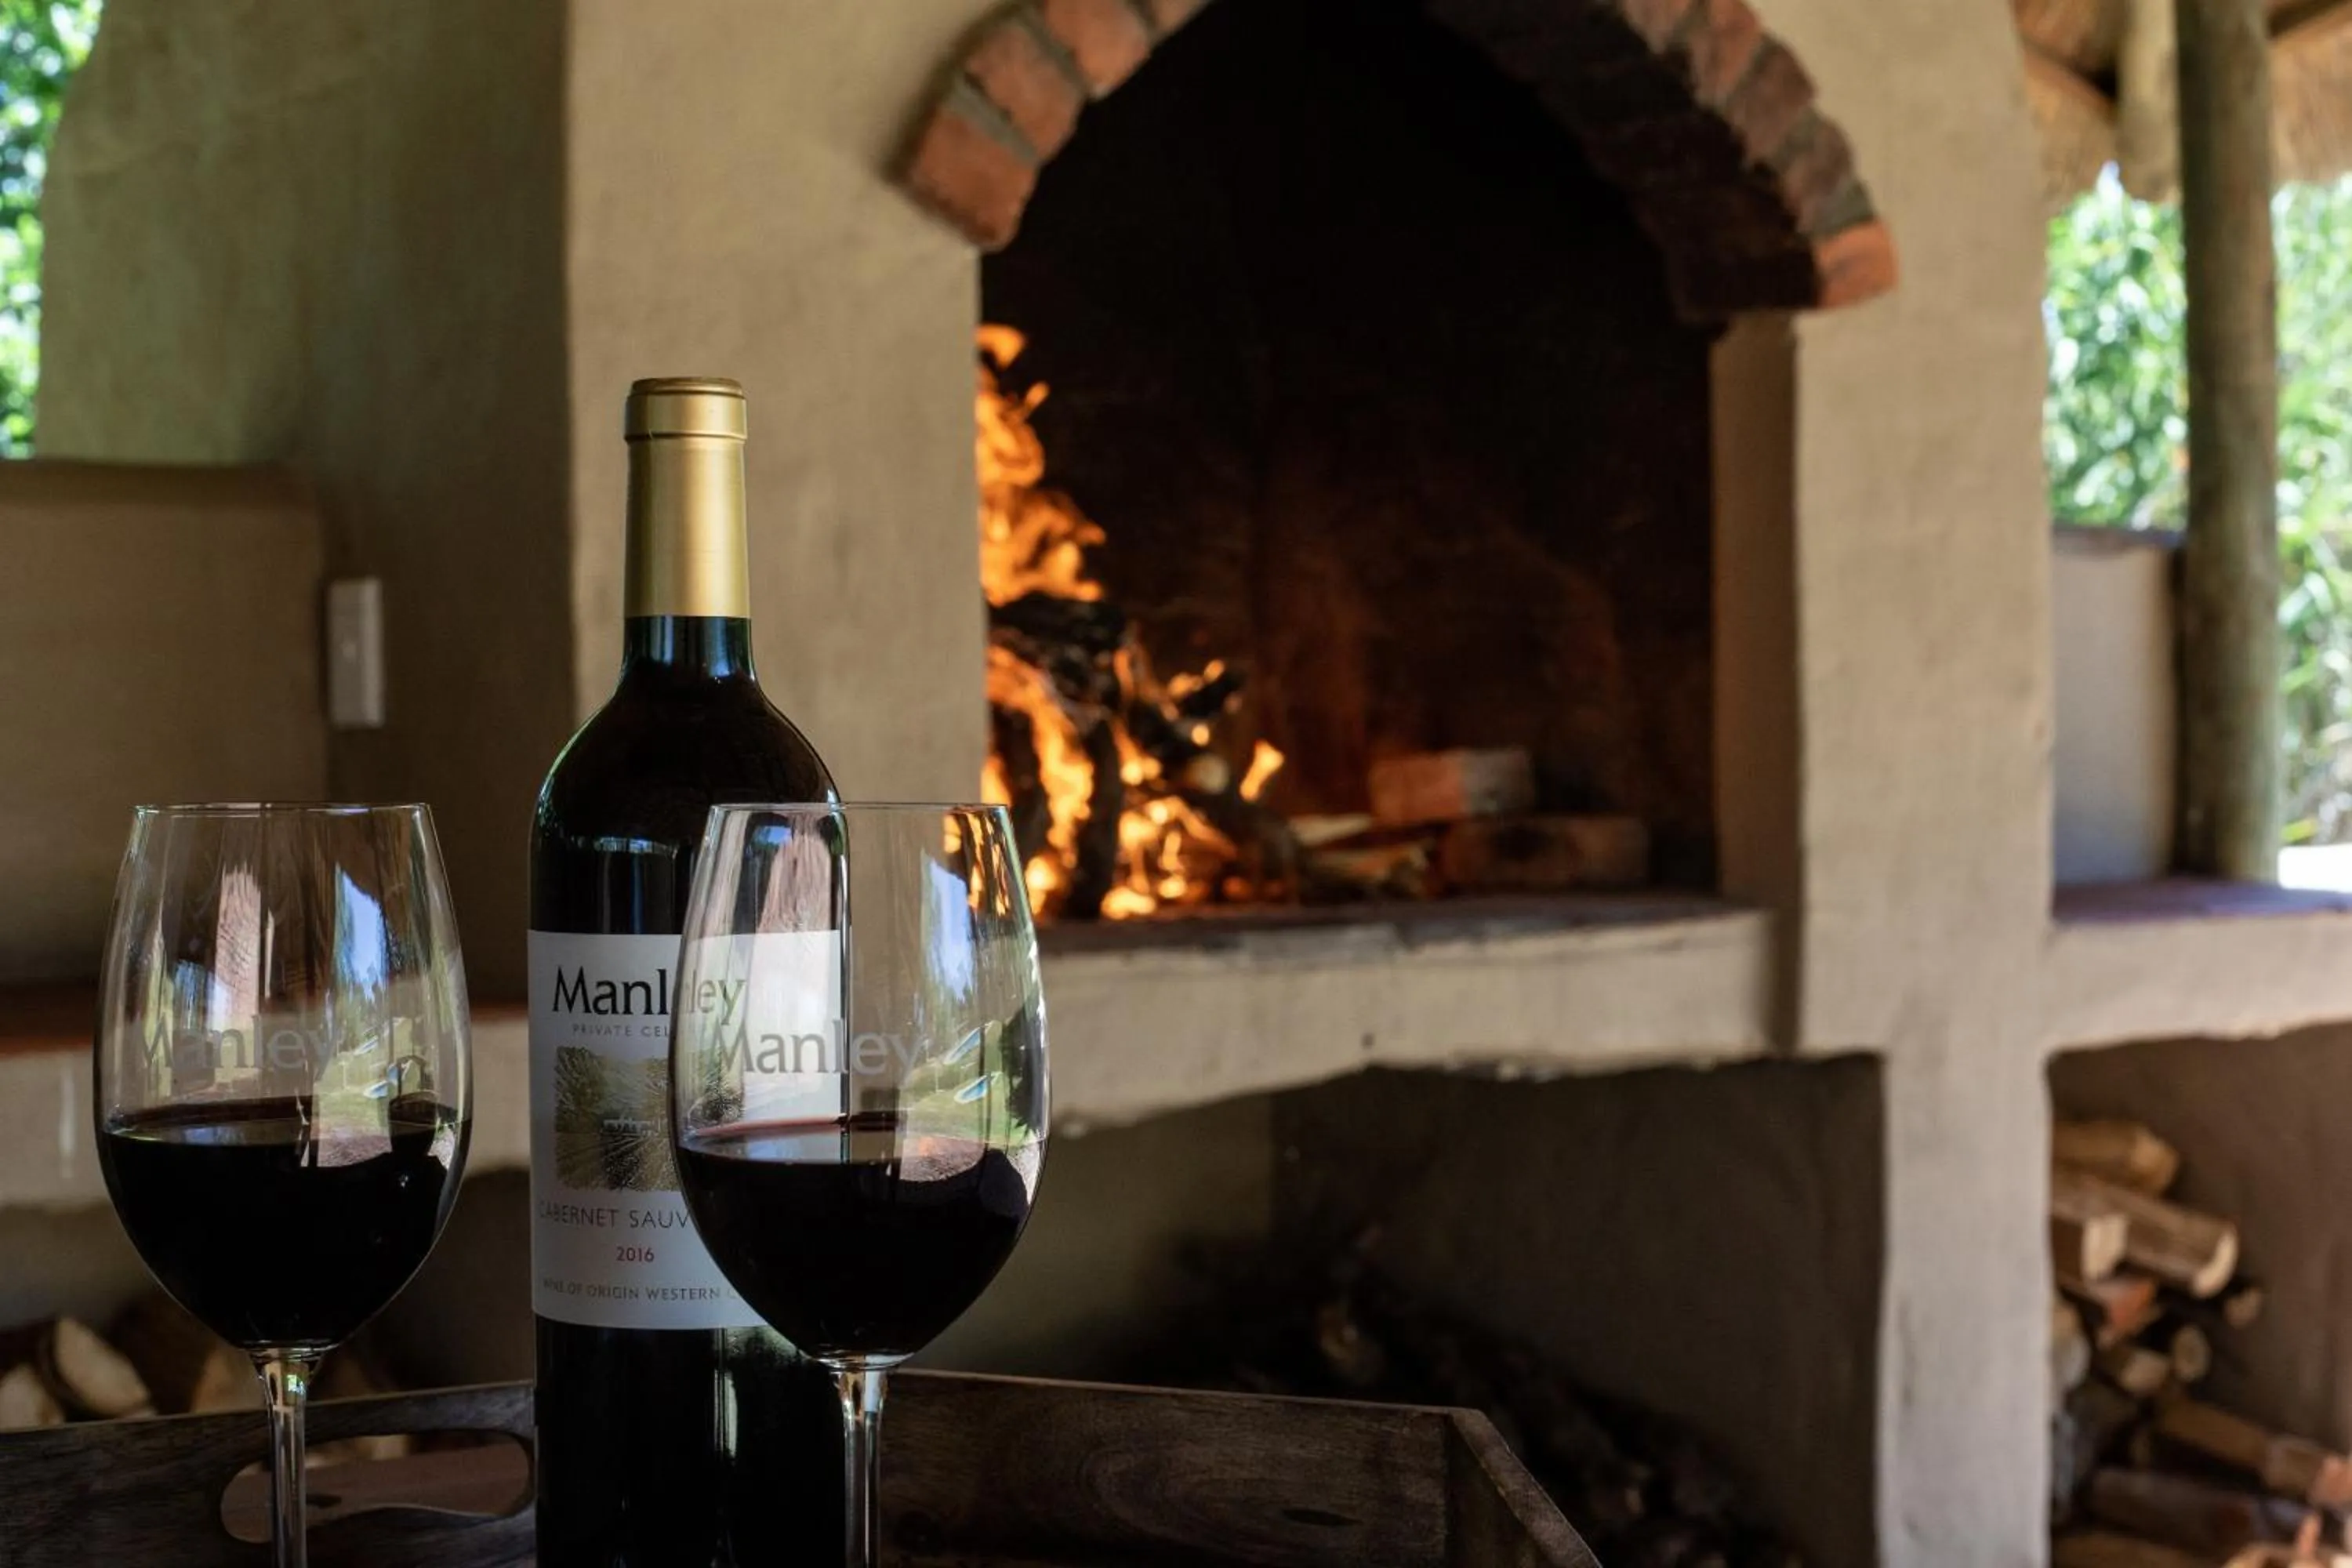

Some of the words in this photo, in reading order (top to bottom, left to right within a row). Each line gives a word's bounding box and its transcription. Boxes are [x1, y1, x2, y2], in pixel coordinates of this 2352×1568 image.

[572, 1022, 633, 1038] PRIVATE
[136, 1011, 338, 1083] Manley
[708, 1017, 933, 1091] Manley
[630, 1210, 688, 1229] SAUV
[615, 1246, 655, 1263] 2016
[567, 1283, 583, 1296] OF
[587, 1284, 639, 1301] ORIGIN
[645, 1287, 720, 1302] WESTERN
